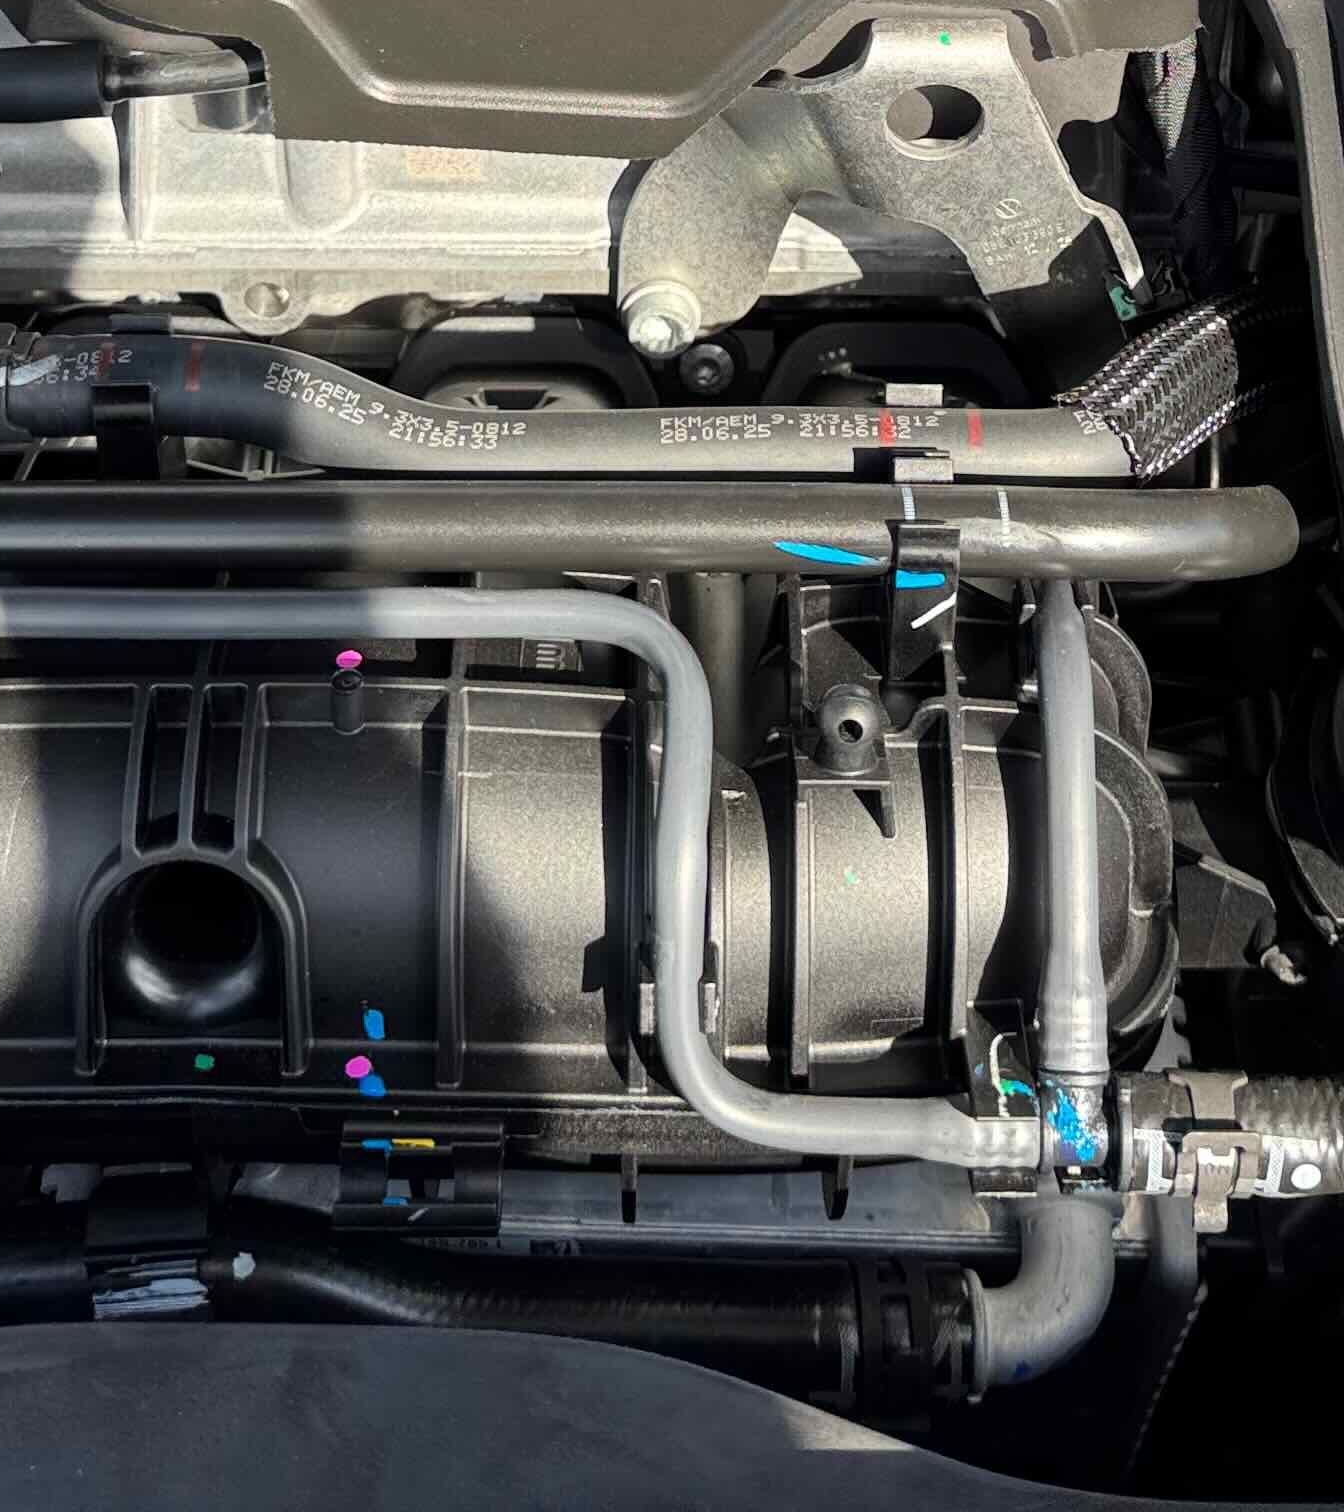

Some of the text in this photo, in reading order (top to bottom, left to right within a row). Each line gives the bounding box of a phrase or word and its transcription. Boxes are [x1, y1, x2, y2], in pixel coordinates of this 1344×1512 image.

[263, 376, 498, 450] 28.06.25 21:56:33
[266, 361, 527, 436] FKM/AEM 9.3X3.5-0812
[659, 413, 757, 430] FKM/AEM
[659, 423, 772, 444] 28.06.25
